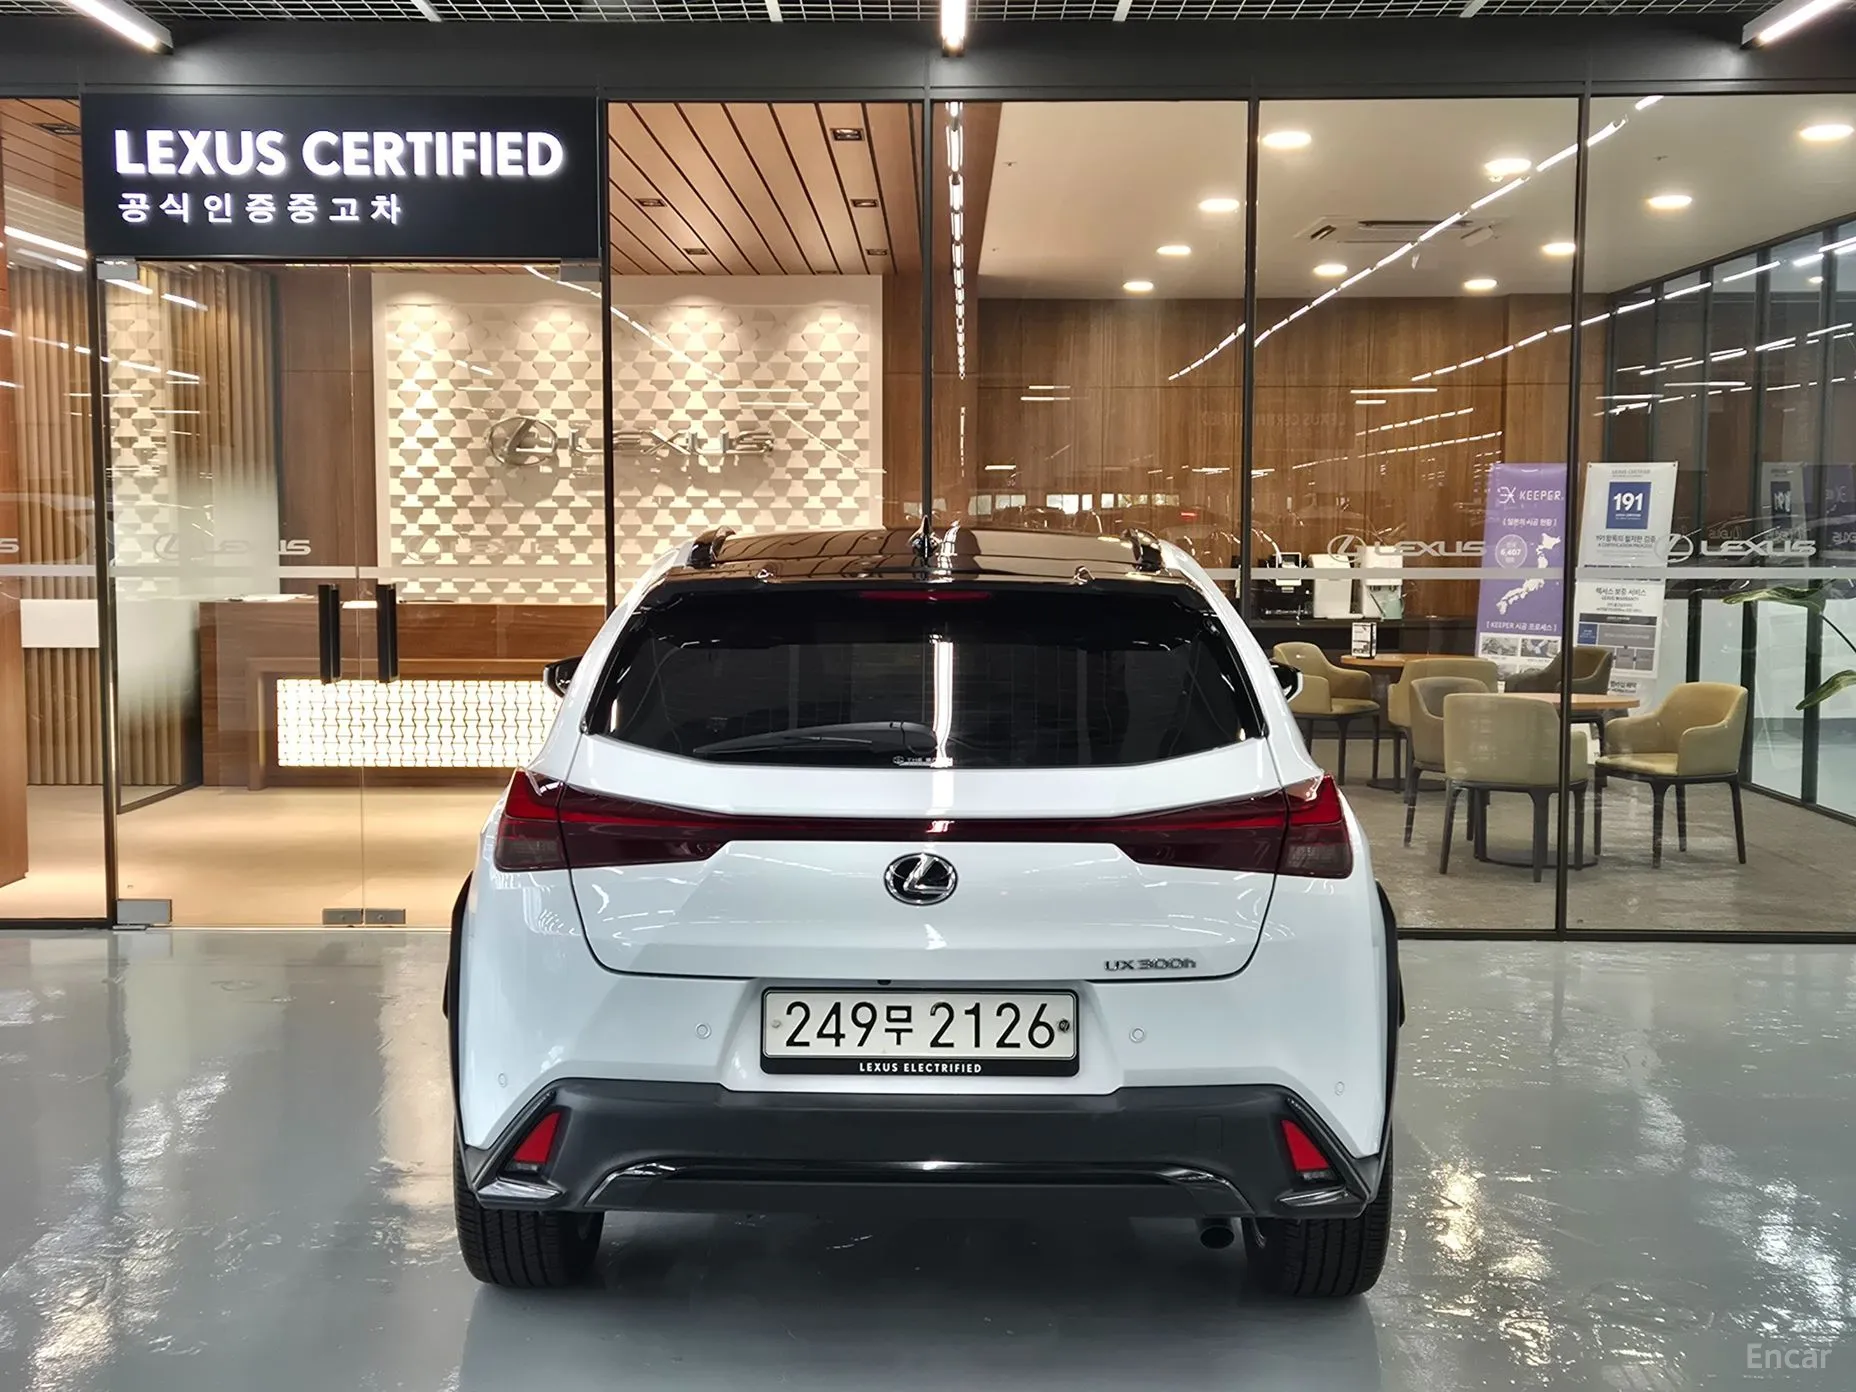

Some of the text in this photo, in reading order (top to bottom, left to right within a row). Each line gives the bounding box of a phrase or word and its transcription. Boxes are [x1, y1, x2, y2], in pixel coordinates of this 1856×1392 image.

[113, 129, 565, 177] LEXUS CERTIFIED
[1519, 490, 1561, 500] KEEPER
[1613, 492, 1643, 511] 191
[1374, 541, 1488, 556] LEXUS
[1699, 540, 1817, 556] LEXUS
[1105, 958, 1197, 971] UX 300h
[785, 1001, 1056, 1049] 249무 2126
[859, 1063, 982, 1074] LEXUS ELECTRIFIED
